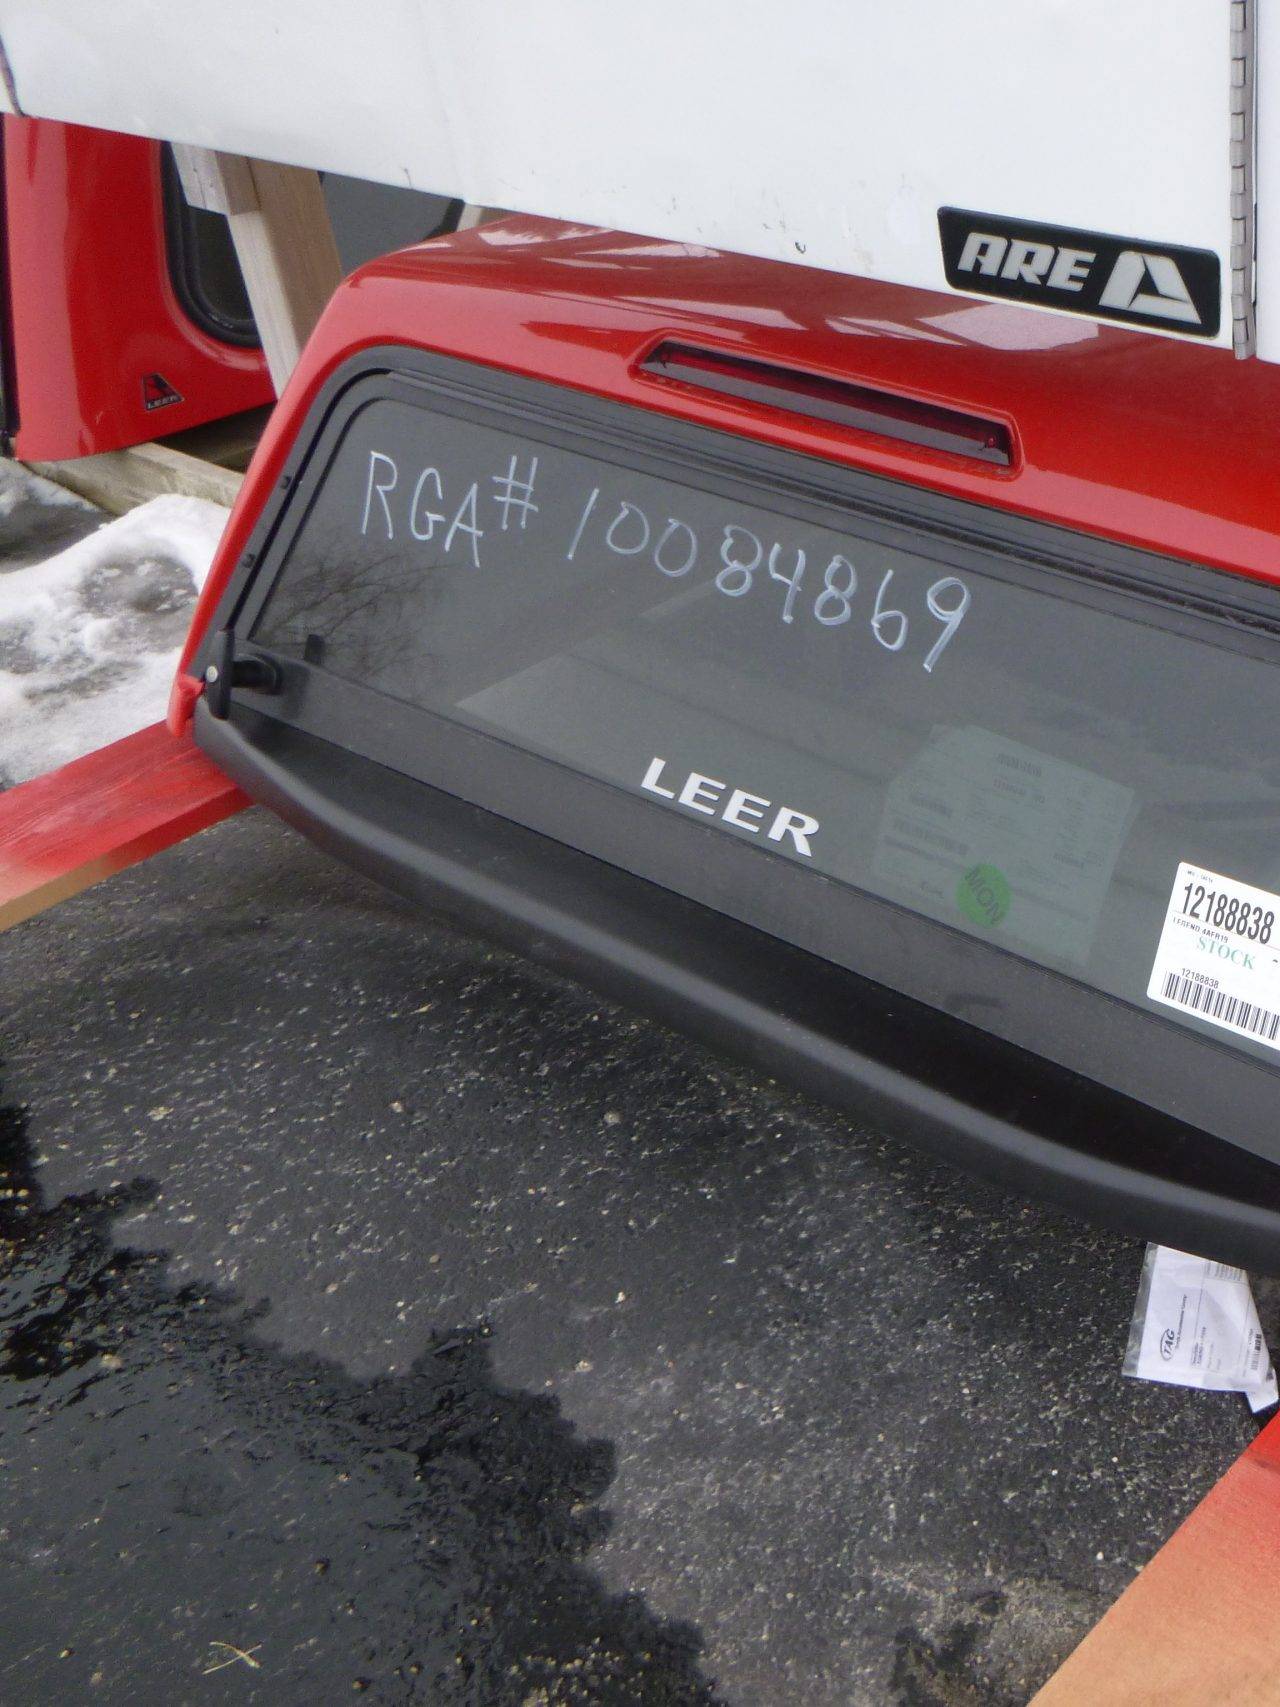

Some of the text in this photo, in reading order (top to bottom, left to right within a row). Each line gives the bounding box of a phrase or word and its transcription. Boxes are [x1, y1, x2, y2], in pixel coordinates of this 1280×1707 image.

[957, 232, 1097, 292] ARE
[362, 450, 539, 568] RGA#
[640, 756, 820, 857] LEER
[1183, 882, 1275, 945] 12188838
[1181, 967, 1220, 990] 12188838
[1197, 936, 1255, 970] STOCK
[1164, 1328, 1175, 1356] TAG
